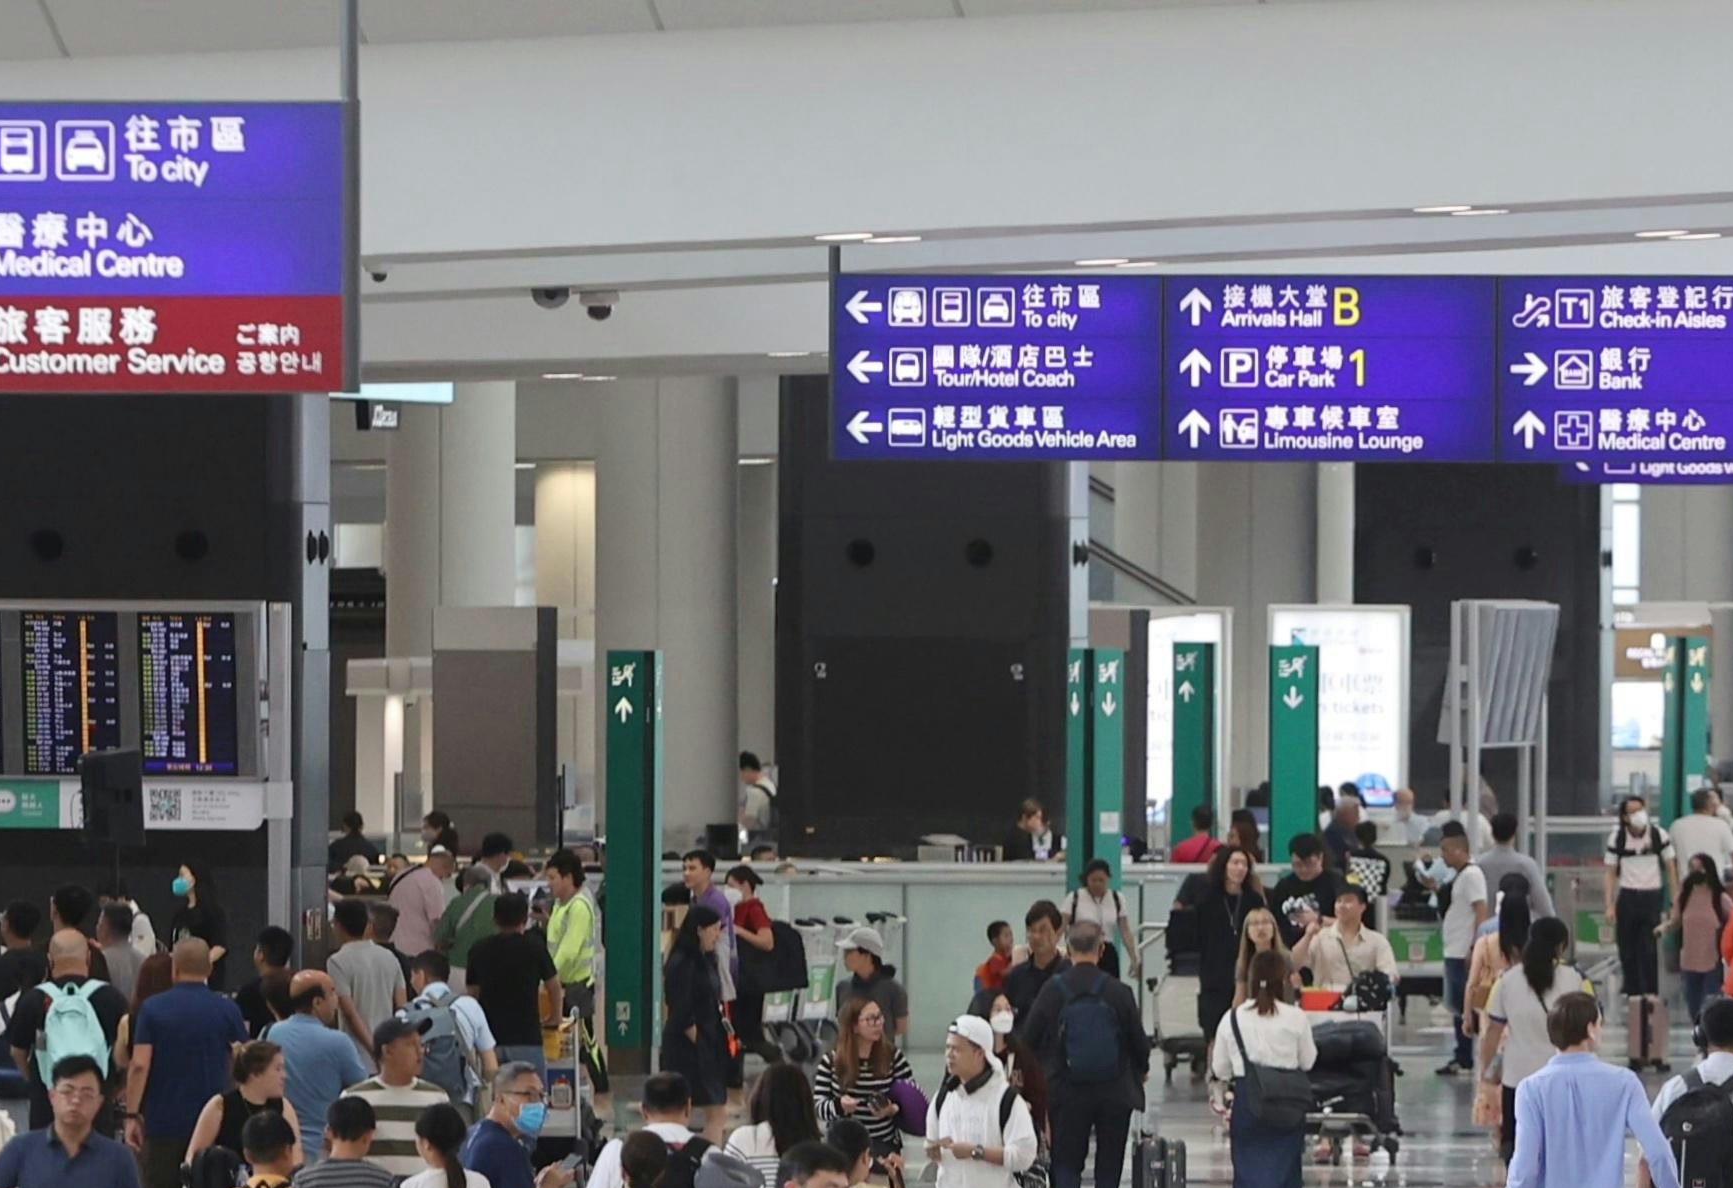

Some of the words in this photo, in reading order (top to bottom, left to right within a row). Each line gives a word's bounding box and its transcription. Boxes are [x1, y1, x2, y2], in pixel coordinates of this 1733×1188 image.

[125, 115, 244, 155] 往市區
[124, 154, 157, 181] To
[161, 155, 209, 187] city
[96, 250, 184, 277] Centre
[1022, 284, 1100, 309] 往市區
[1224, 285, 1327, 311] 接機大堂
[1334, 288, 1359, 325] B
[1561, 296, 1591, 322] T1
[1021, 310, 1044, 327] To
[1049, 310, 1077, 330] city
[1221, 309, 1286, 327] Arrivals
[1290, 310, 1322, 327] Hall
[1600, 310, 1672, 328] Check-in
[1674, 311, 1726, 328] Aisles
[237, 323, 299, 345] ご案内
[128, 347, 225, 374] Service
[237, 351, 321, 374] 공항안내
[933, 344, 1093, 372] 團隊/酒店巴士
[1266, 345, 1343, 372] 停車場
[1350, 349, 1364, 386] 1
[1600, 347, 1651, 373] 銀行
[933, 369, 1019, 387] Tour/Hotel
[1023, 369, 1074, 387] Coach
[1265, 370, 1295, 387] Car
[1298, 370, 1335, 387] Park
[1599, 371, 1642, 389] Bank
[933, 405, 1065, 430] 輕型貨車區
[1265, 405, 1399, 430] 專車候車室
[1599, 408, 1705, 434] 醫療中心
[932, 428, 974, 451] Light
[978, 428, 1033, 447] Goods
[1035, 430, 1094, 448] Vehicle
[1096, 430, 1136, 448] Area
[1264, 432, 1353, 449] Limousine
[1359, 432, 1423, 453] Lounge
[1598, 431, 1666, 450] Medical
[1666, 431, 1726, 450] Centre
[1676, 463, 1722, 474] Goods
